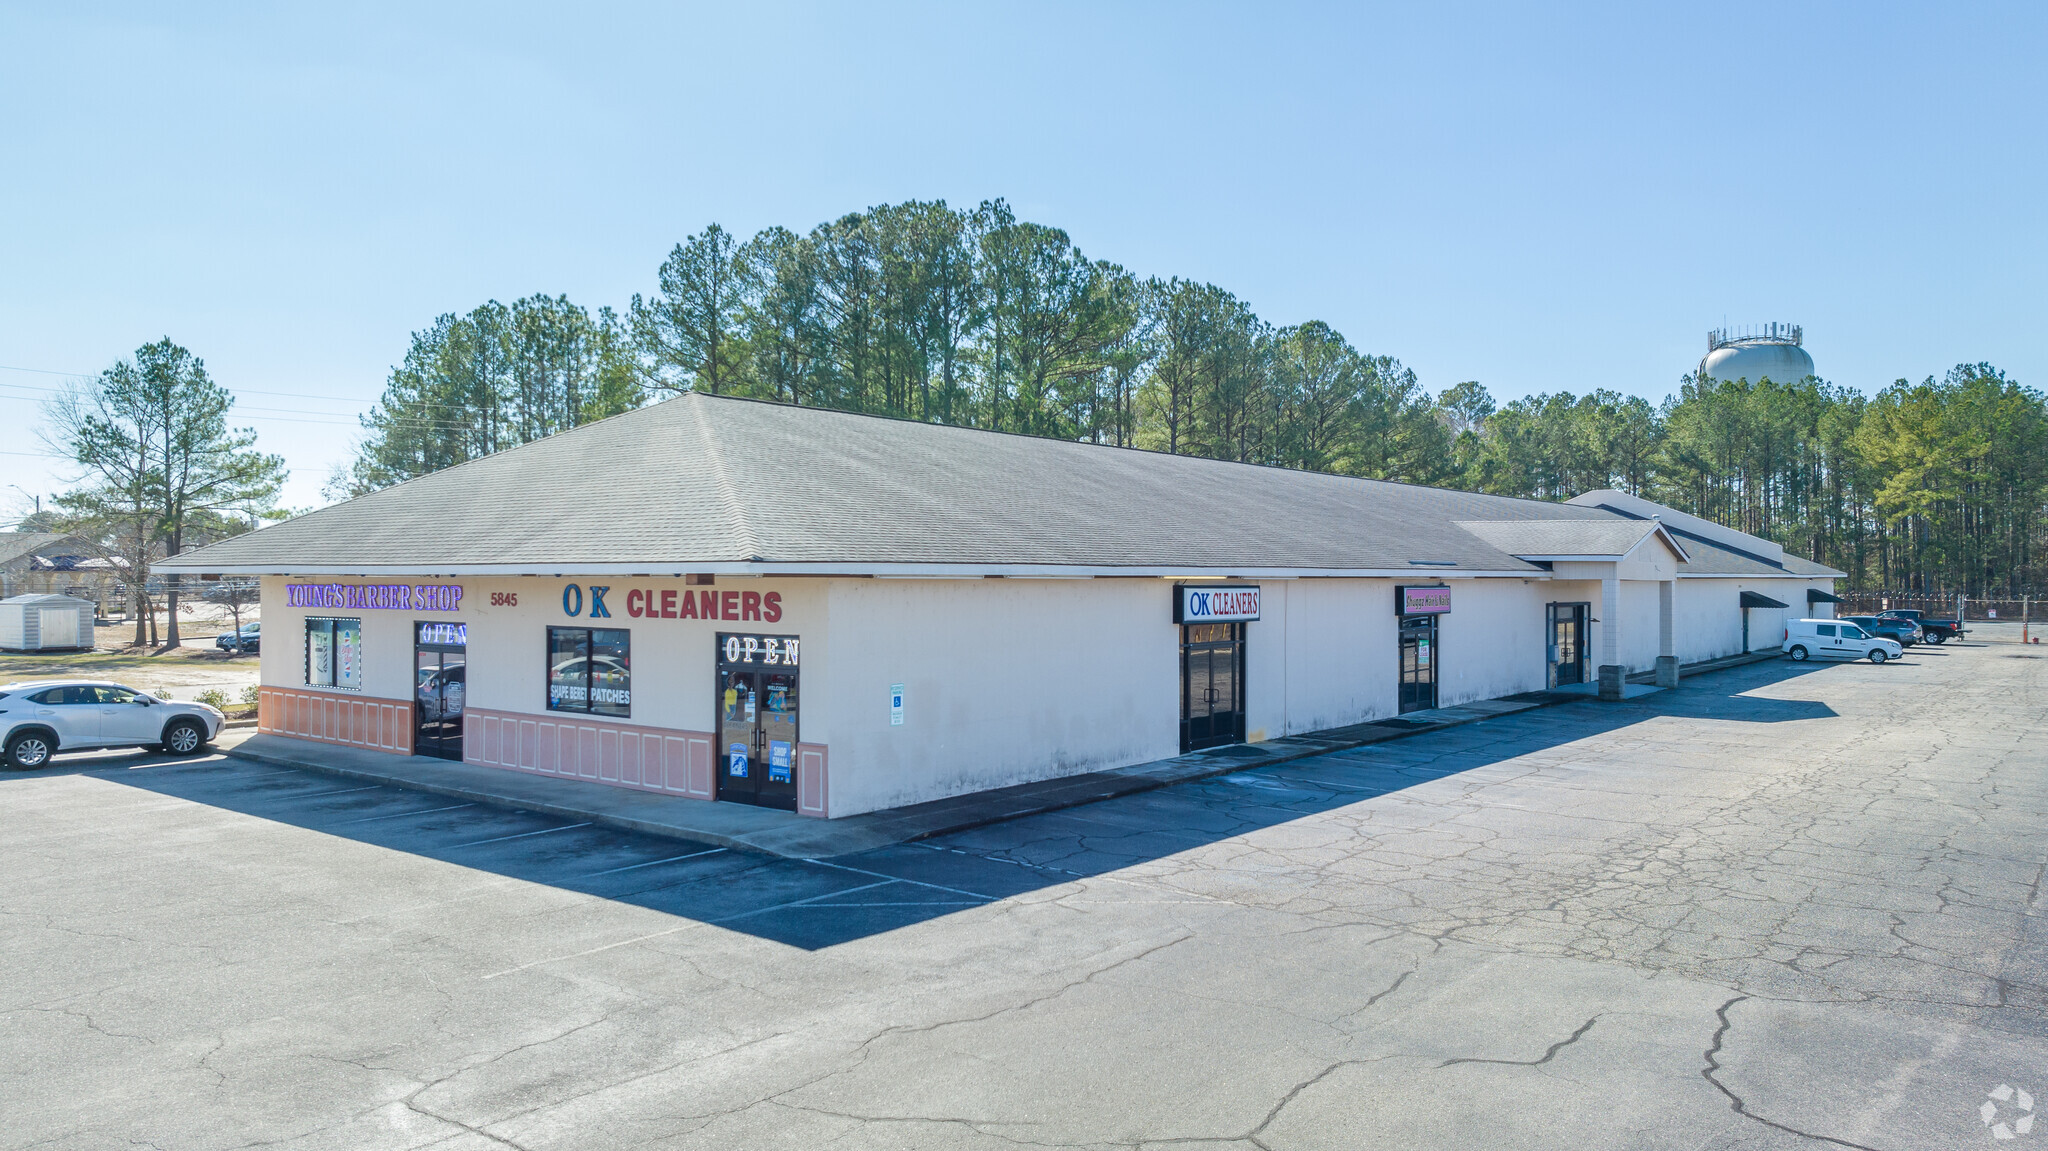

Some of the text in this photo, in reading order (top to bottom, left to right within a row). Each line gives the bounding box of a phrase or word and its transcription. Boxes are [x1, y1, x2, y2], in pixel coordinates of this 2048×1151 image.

[286, 583, 463, 611] YOUNG'S BARBER SHOP
[490, 592, 518, 607] 5845
[626, 588, 783, 623] CLEANERS
[1190, 592, 1258, 616] OK CLEANERS
[422, 623, 466, 645] OPEN
[726, 636, 799, 665] OPEN
[551, 684, 630, 704] SHAPE BERET PATCHES
[772, 756, 789, 767] SMALL
[773, 746, 787, 757] SHOP
